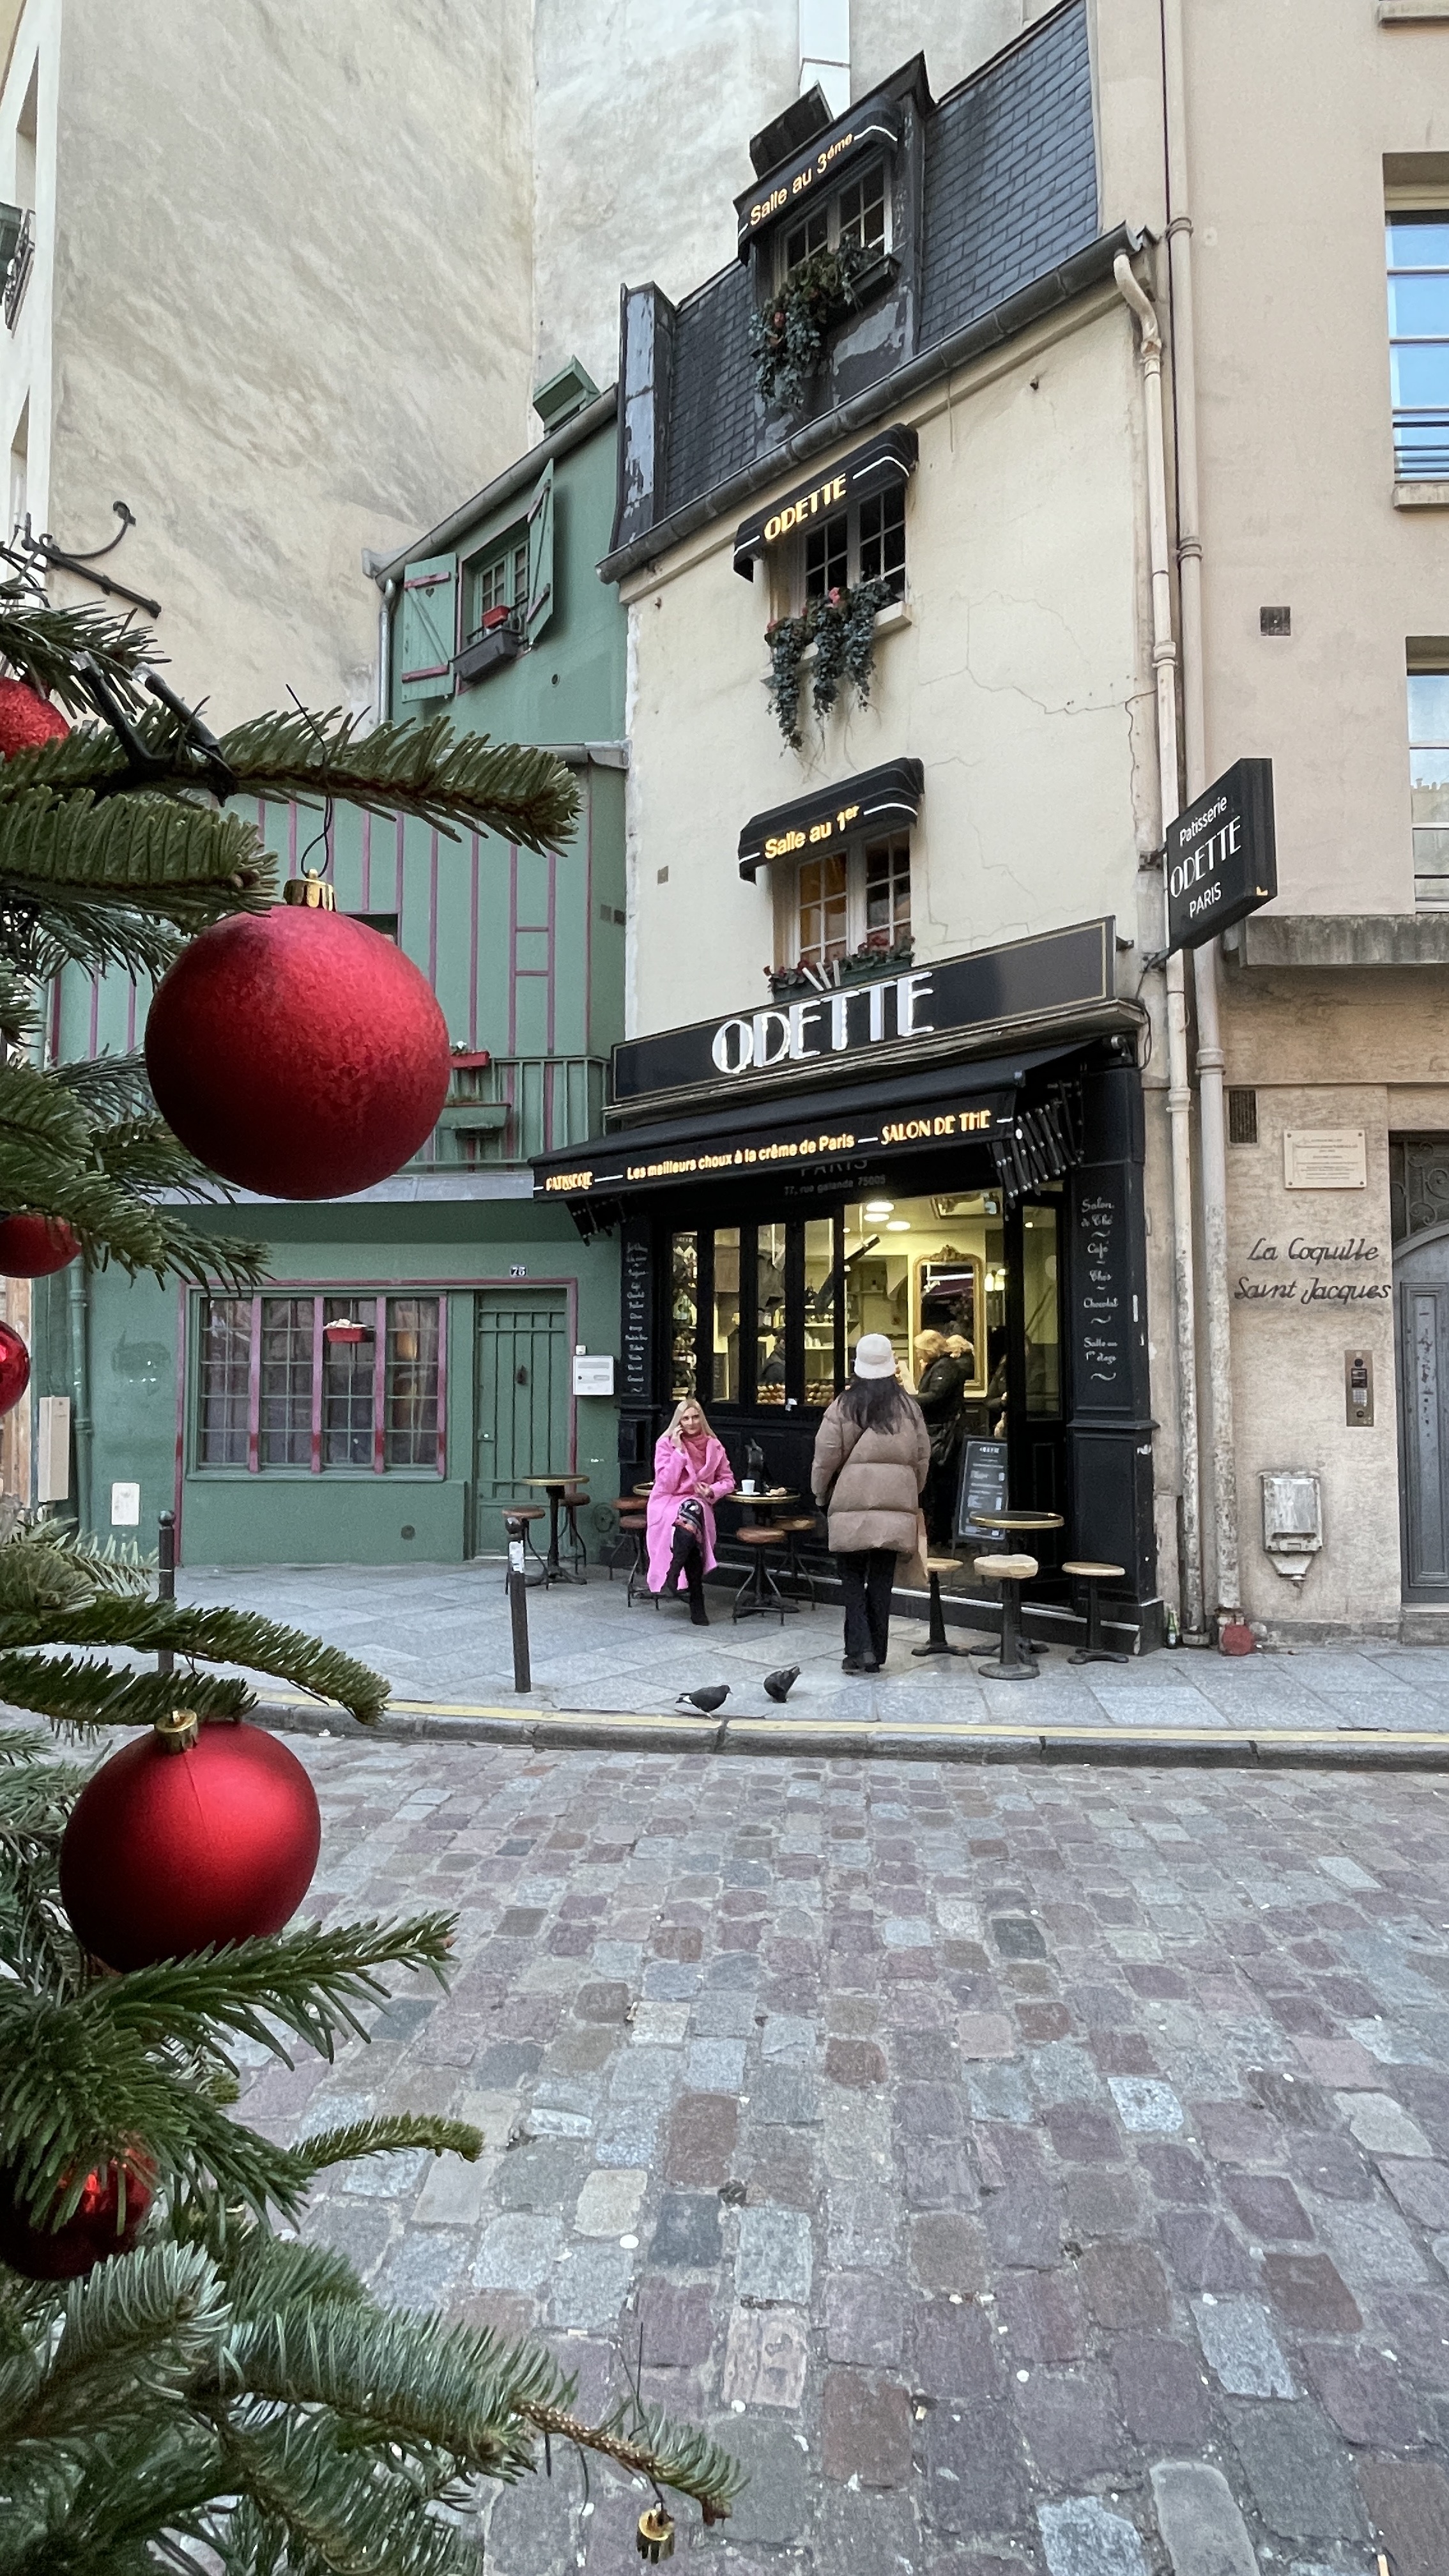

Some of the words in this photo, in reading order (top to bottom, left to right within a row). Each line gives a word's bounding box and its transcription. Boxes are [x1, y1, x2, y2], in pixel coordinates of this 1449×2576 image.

[750, 188, 788, 226] Salle
[792, 167, 812, 194] au
[764, 473, 847, 540] ODETTE
[765, 831, 806, 859] Salle
[809, 822, 832, 843] au
[837, 805, 859, 831] 1er
[1180, 796, 1227, 847] Patisserie
[1170, 815, 1241, 898] ODETTE
[1189, 882, 1222, 918] PARIS
[712, 972, 934, 1073] ODETTE
[627, 1167, 646, 1180] Les
[648, 1158, 696, 1176] meilleurs
[698, 1153, 732, 1170] choux
[734, 1149, 742, 1163] à
[745, 1149, 756, 1163] la
[799, 1139, 816, 1154] de
[819, 1133, 855, 1152] Paris
[881, 1120, 931, 1145] SALON
[934, 1115, 956, 1135] DE
[512, 1266, 525, 1276] 75
[1246, 1238, 1278, 1261] La
[1288, 1237, 1379, 1266] Coquille
[1234, 1276, 1298, 1300] Saint
[1301, 1277, 1392, 1305] Jacques
